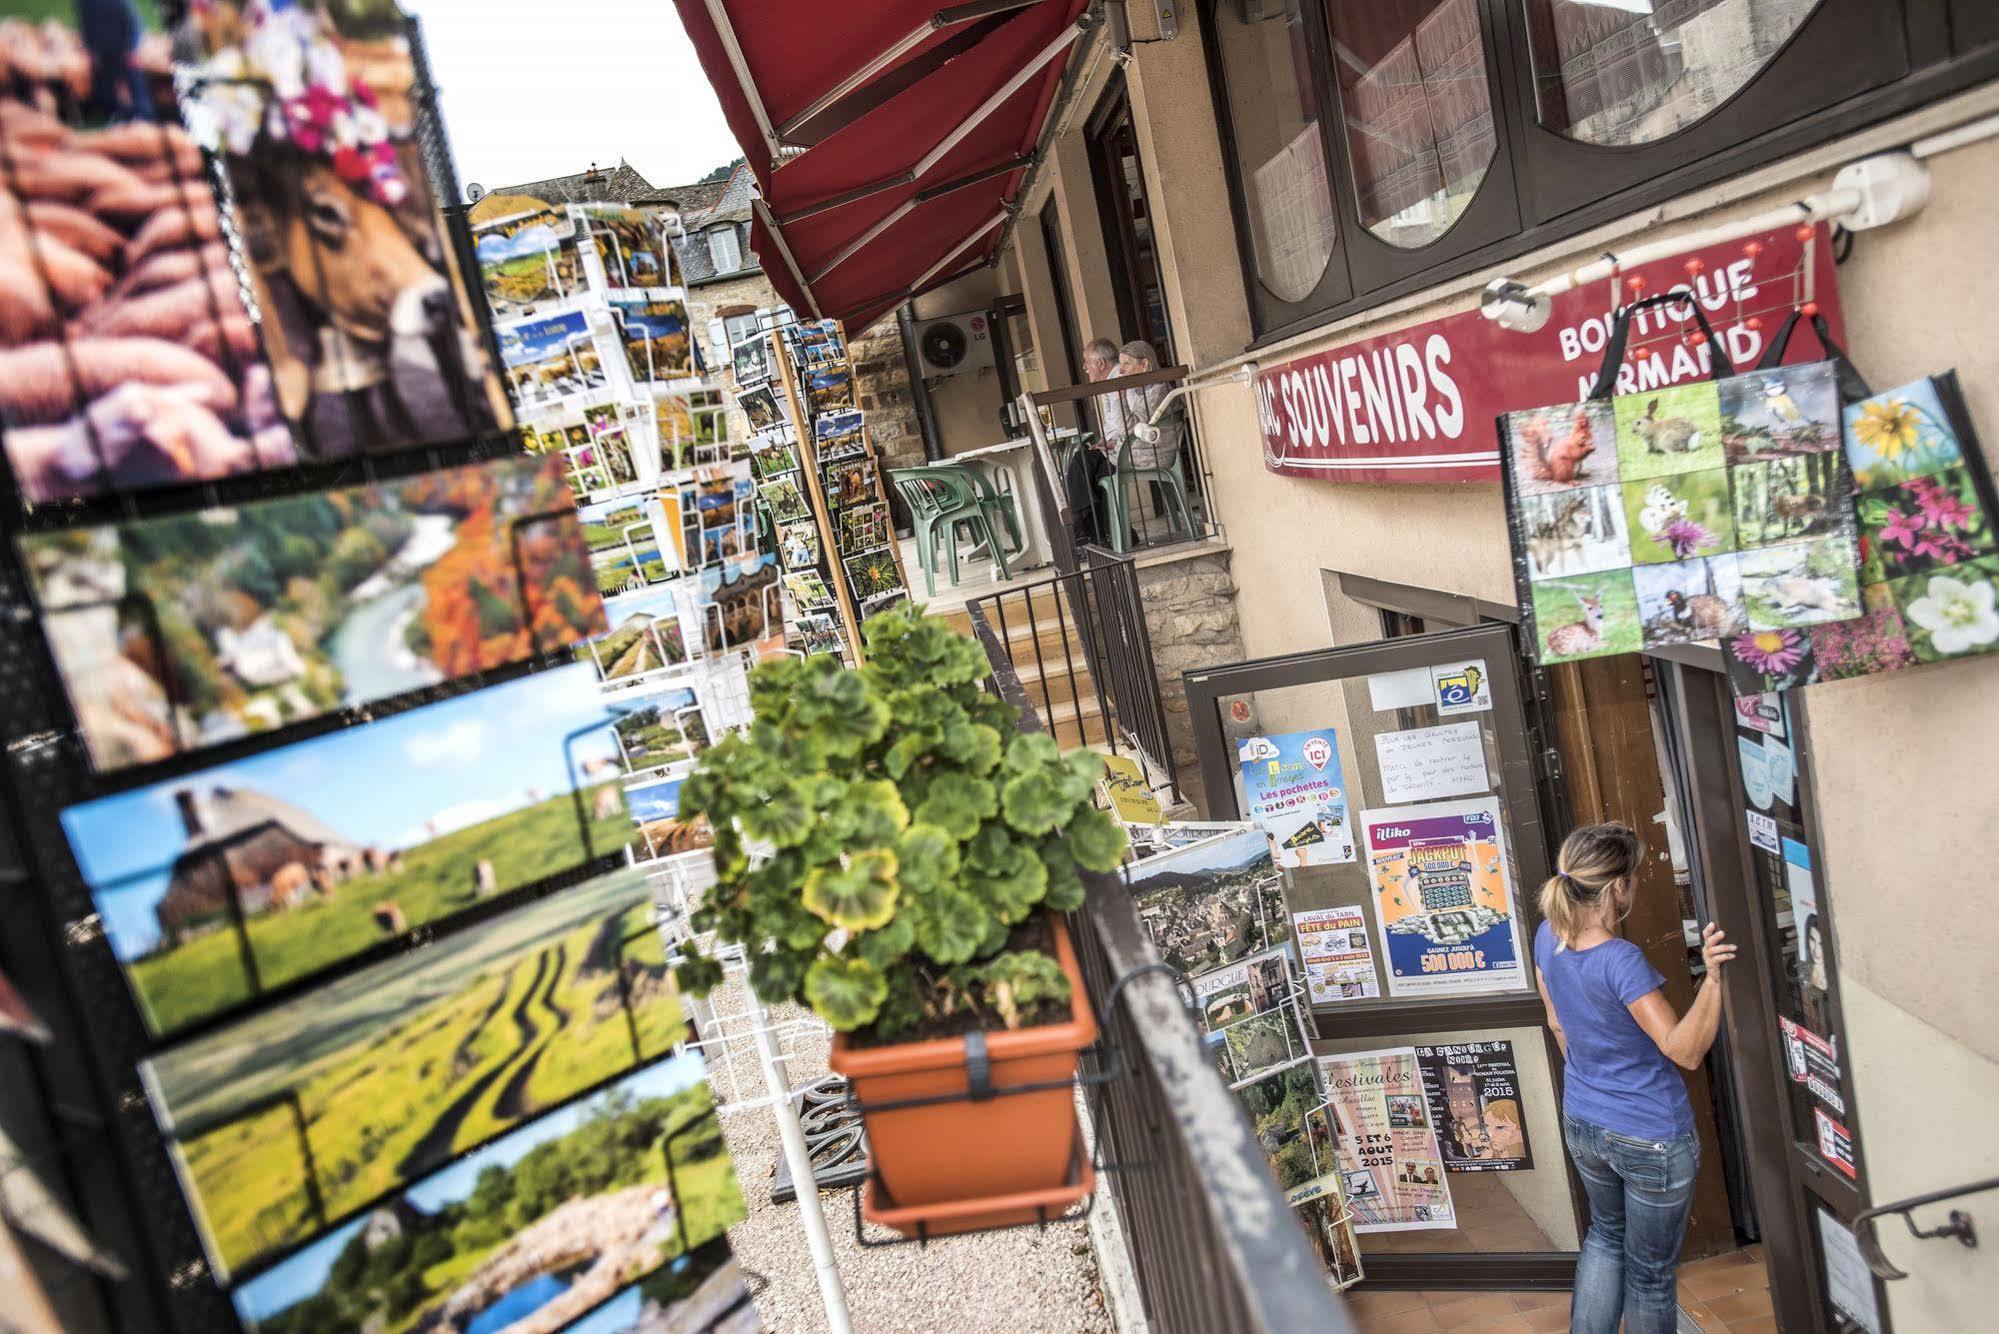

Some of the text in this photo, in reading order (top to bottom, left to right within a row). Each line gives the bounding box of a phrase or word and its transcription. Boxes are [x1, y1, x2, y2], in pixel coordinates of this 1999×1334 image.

[974, 333, 986, 341] LG
[1578, 322, 1762, 404] NRMAND
[1280, 333, 1464, 448] SOUVENIRS
[1309, 750, 1326, 761] ICI
[1260, 779, 1329, 801] Les pochettes
[1408, 844, 1467, 866] JACKPOT
[1324, 921, 1336, 930] du
[1337, 918, 1361, 928] PAIN
[1420, 953, 1448, 973] 500
[1448, 951, 1475, 970] 000
[1474, 950, 1486, 968] €
[1483, 1086, 1514, 1097] 2015
[1355, 1136, 1363, 1145] 5
[1366, 1133, 1382, 1143] ET
[1384, 1133, 1391, 1142] 6
[1358, 1145, 1394, 1156] AOUT
[1362, 1156, 1394, 1167] 2015
